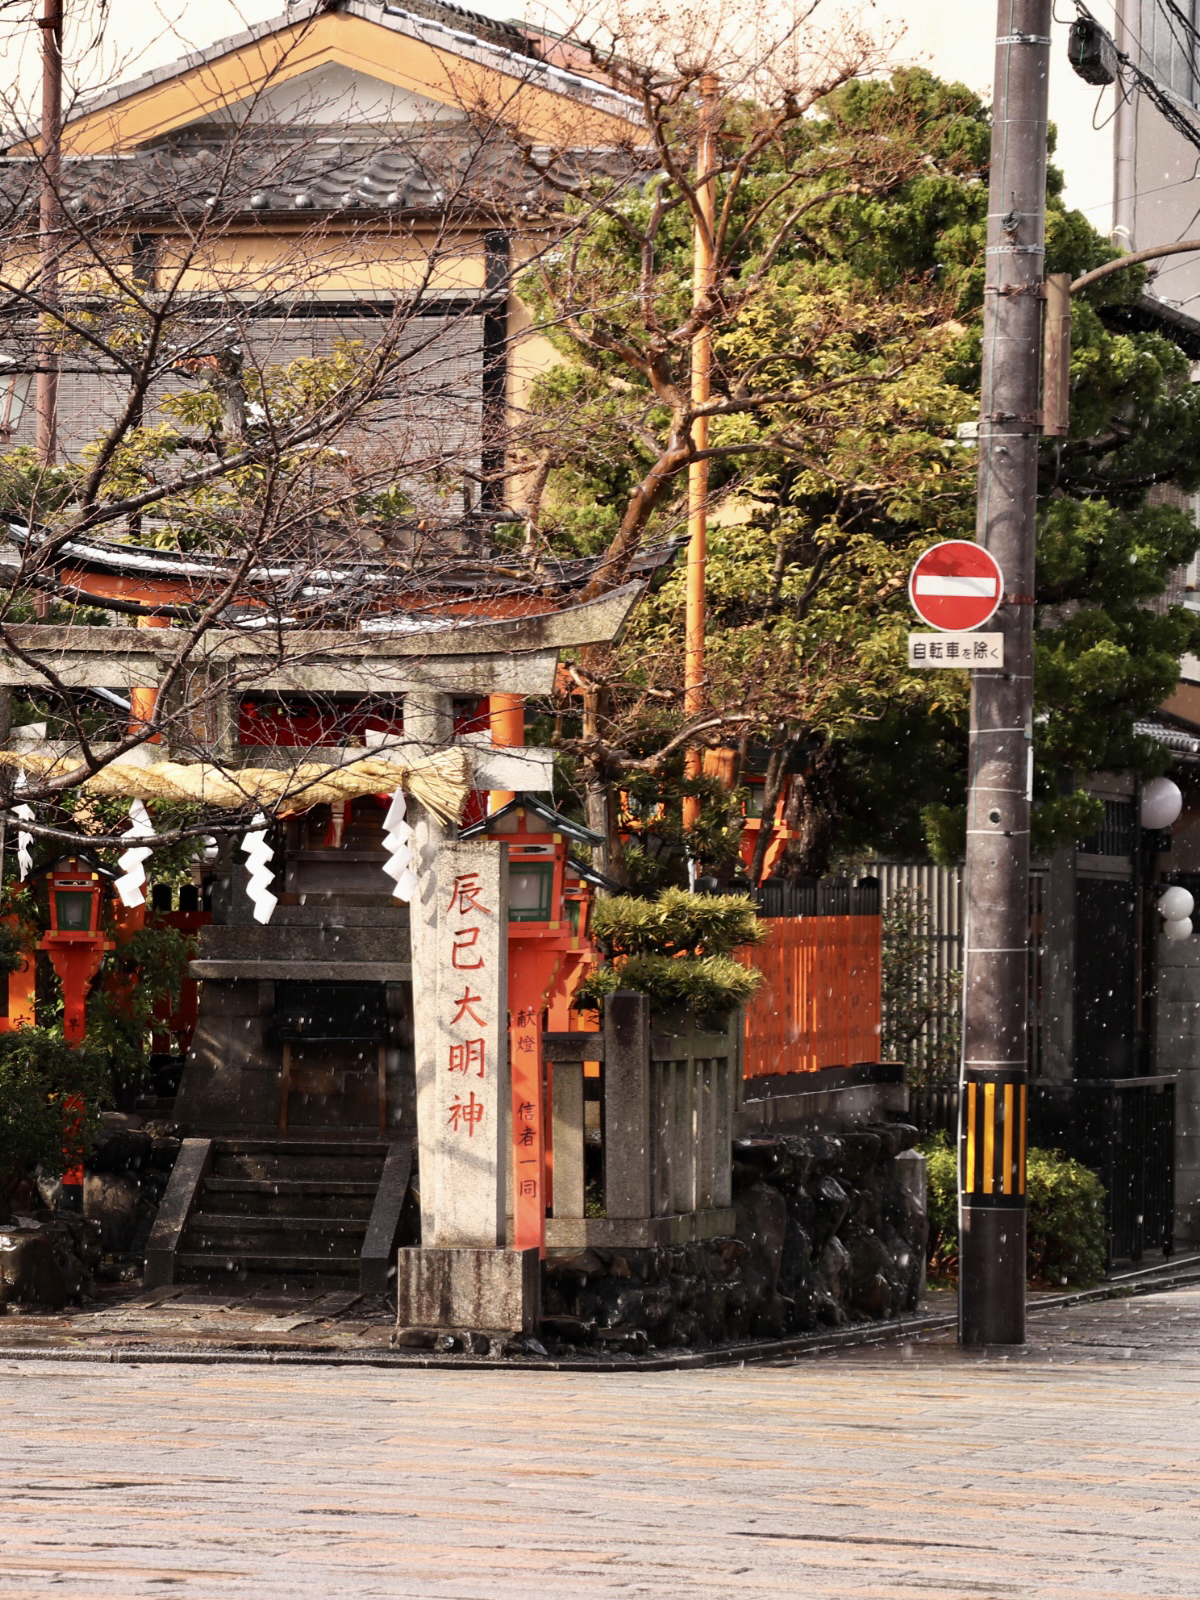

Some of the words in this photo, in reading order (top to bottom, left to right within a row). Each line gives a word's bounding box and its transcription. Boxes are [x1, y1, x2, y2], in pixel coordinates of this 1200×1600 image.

[913, 641, 999, 660] 自転車を除く
[517, 1101, 537, 1198] 信者一同
